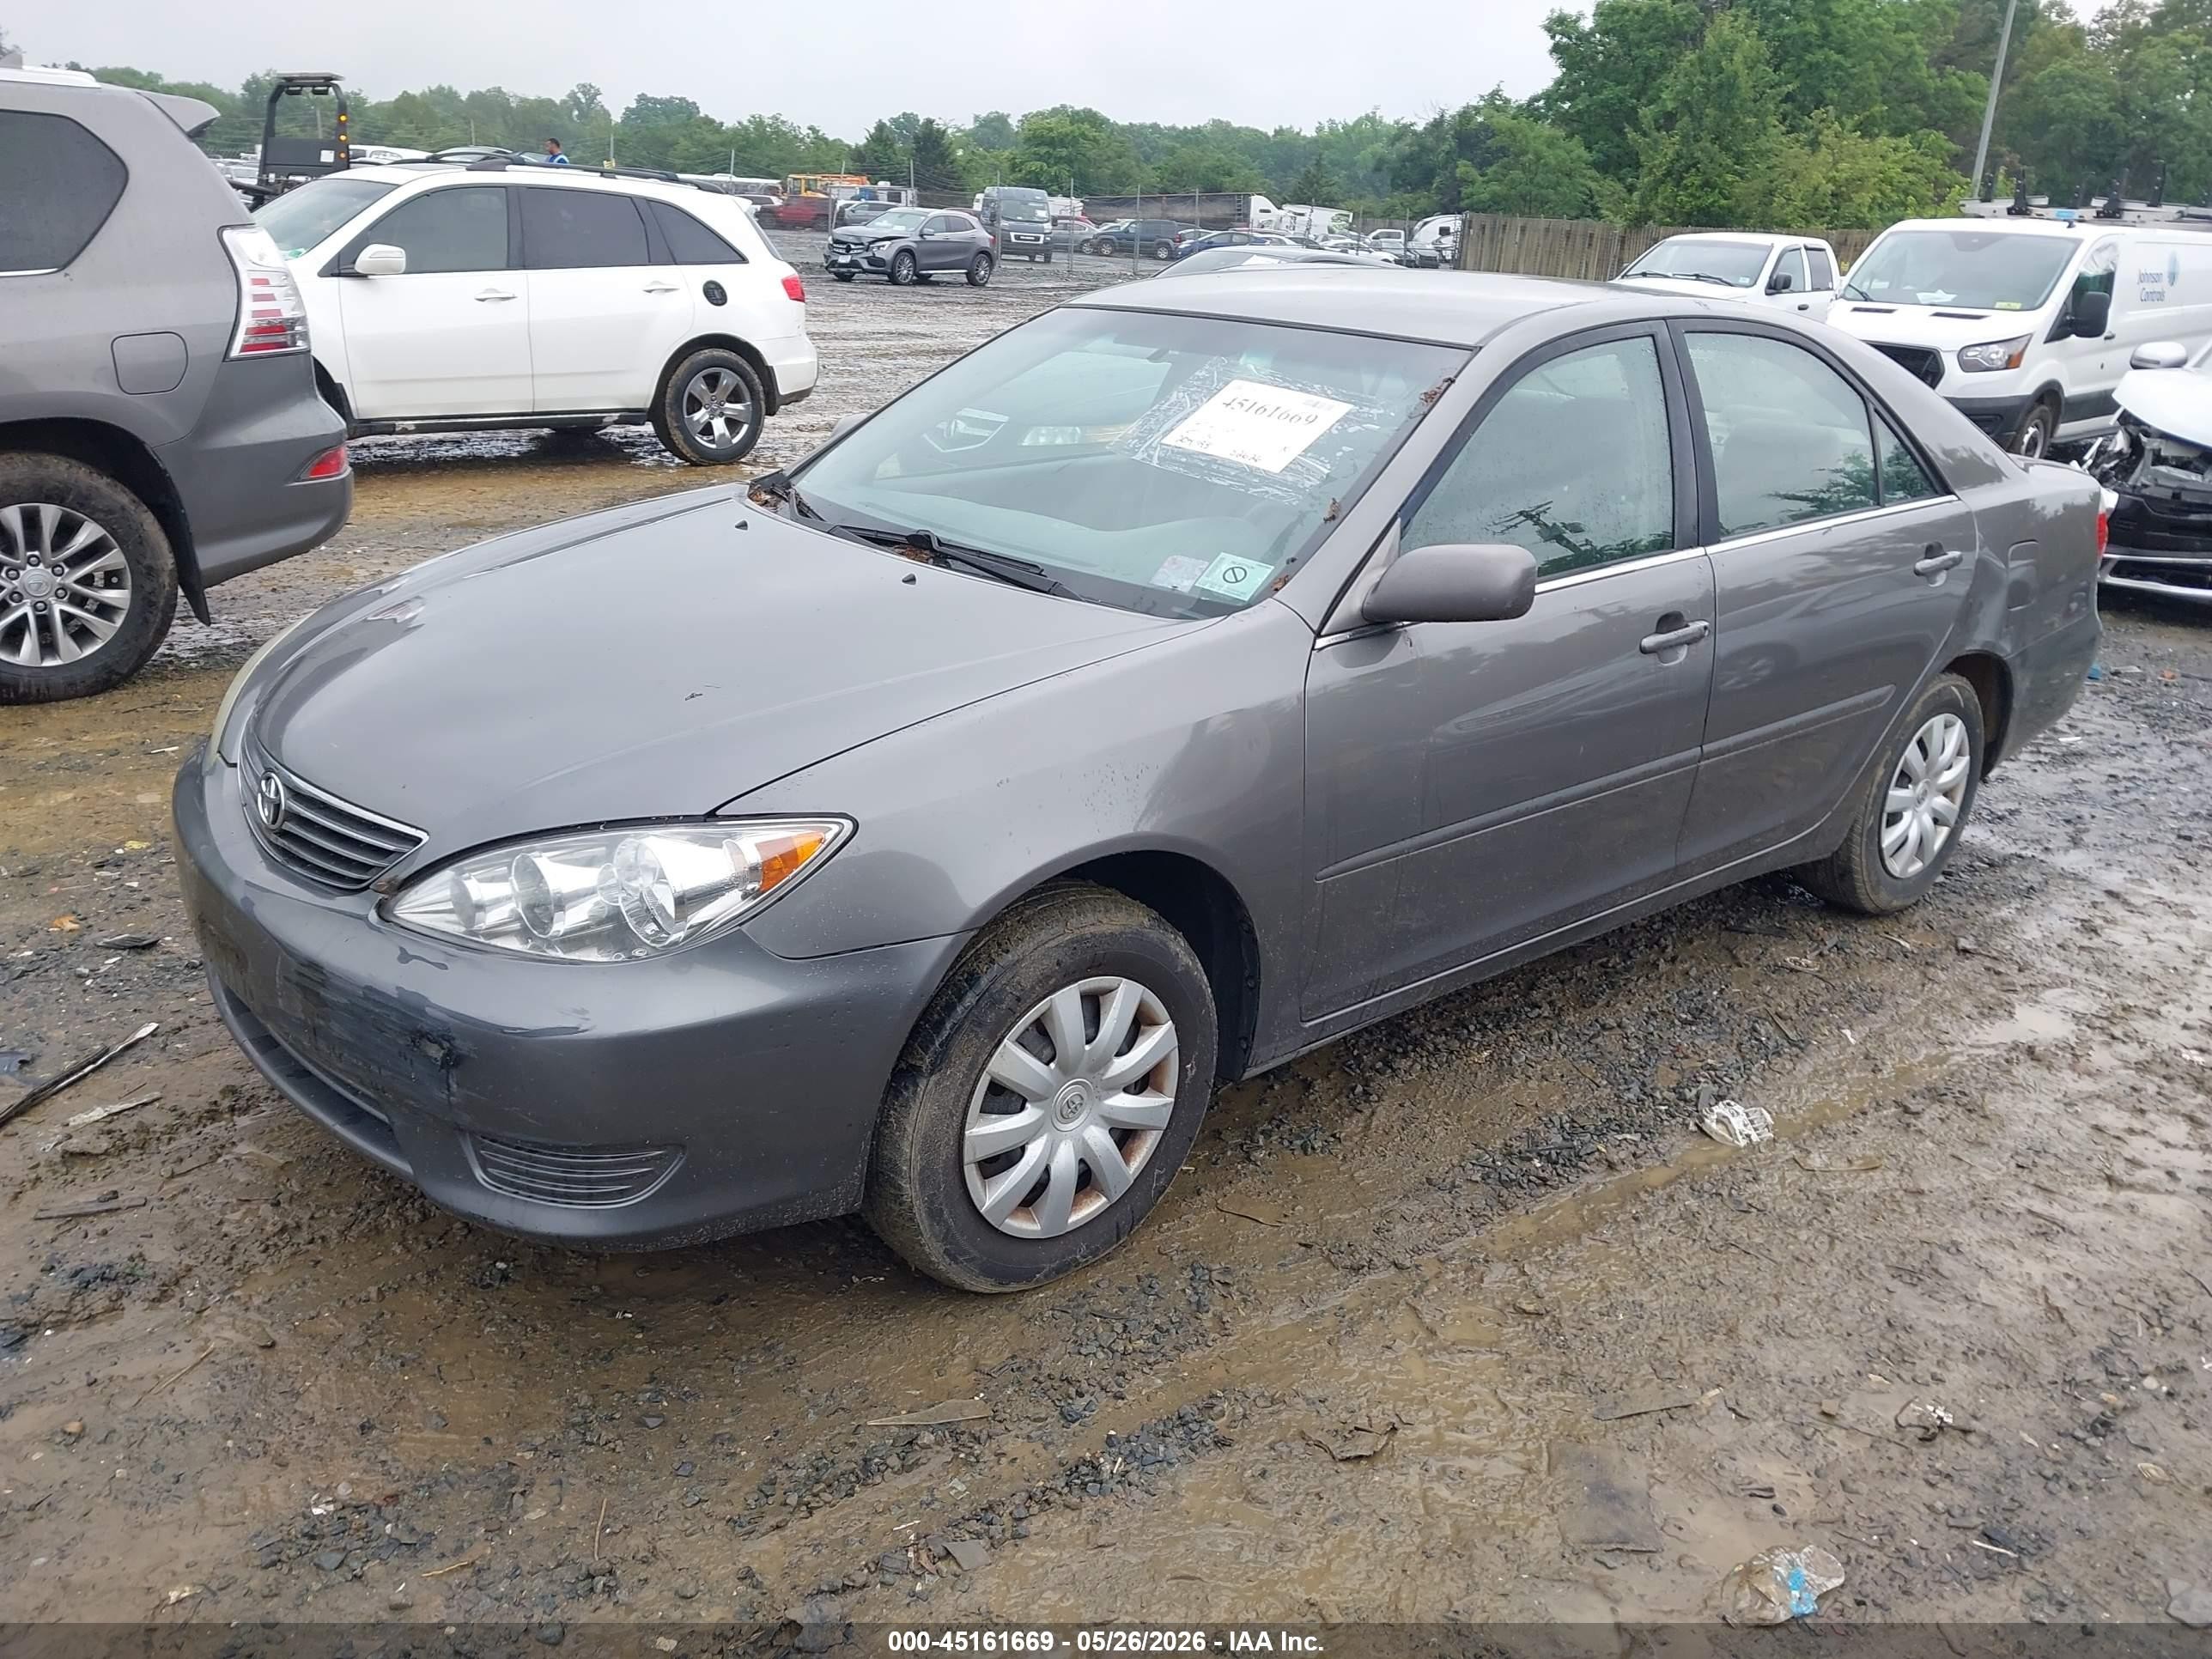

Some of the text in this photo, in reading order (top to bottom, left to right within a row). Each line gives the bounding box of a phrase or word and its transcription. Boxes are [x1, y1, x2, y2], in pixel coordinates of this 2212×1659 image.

[2136, 269, 2163, 285] Johnson
[2140, 287, 2165, 302] Controls
[1222, 396, 1319, 425] 45161669
